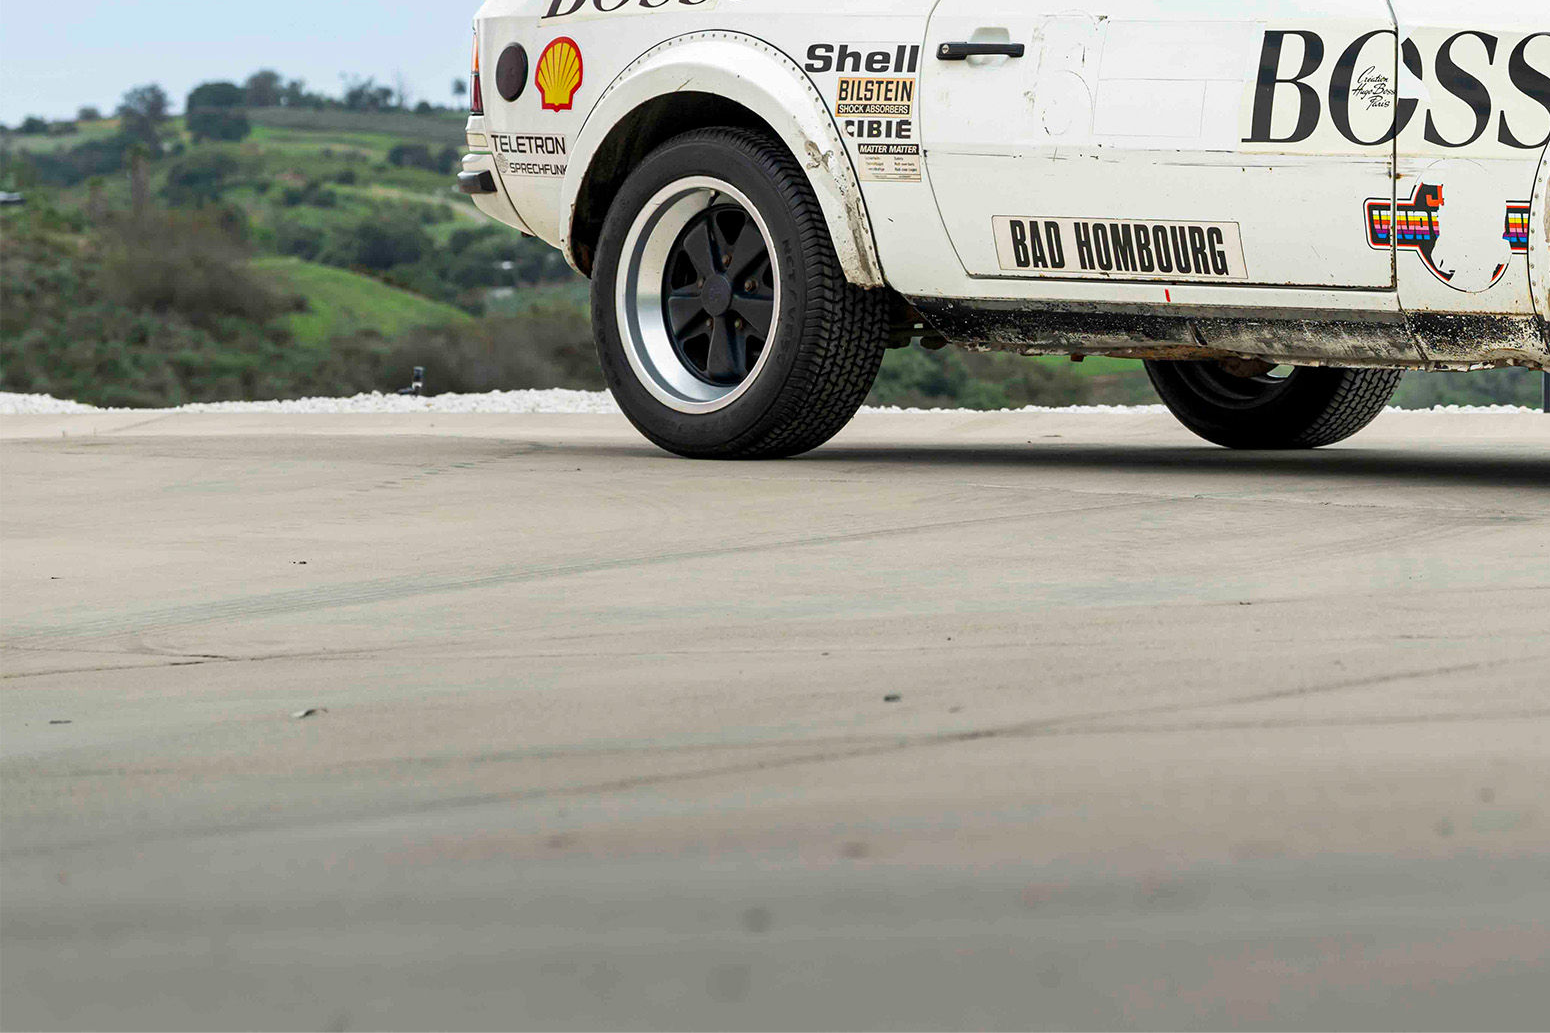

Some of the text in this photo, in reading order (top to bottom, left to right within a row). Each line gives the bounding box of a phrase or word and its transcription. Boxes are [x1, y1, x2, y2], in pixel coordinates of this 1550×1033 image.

[805, 43, 920, 73] Shell
[838, 79, 913, 102] BILSTEIN
[1352, 82, 1374, 99] Hugo
[839, 104, 909, 114] SHOCK ABSORBERS
[1366, 95, 1390, 111] Paris
[491, 134, 566, 155] TELETRON
[859, 145, 917, 154] MATTER MATTER
[1009, 220, 1230, 276] BAD HOMBOURG
